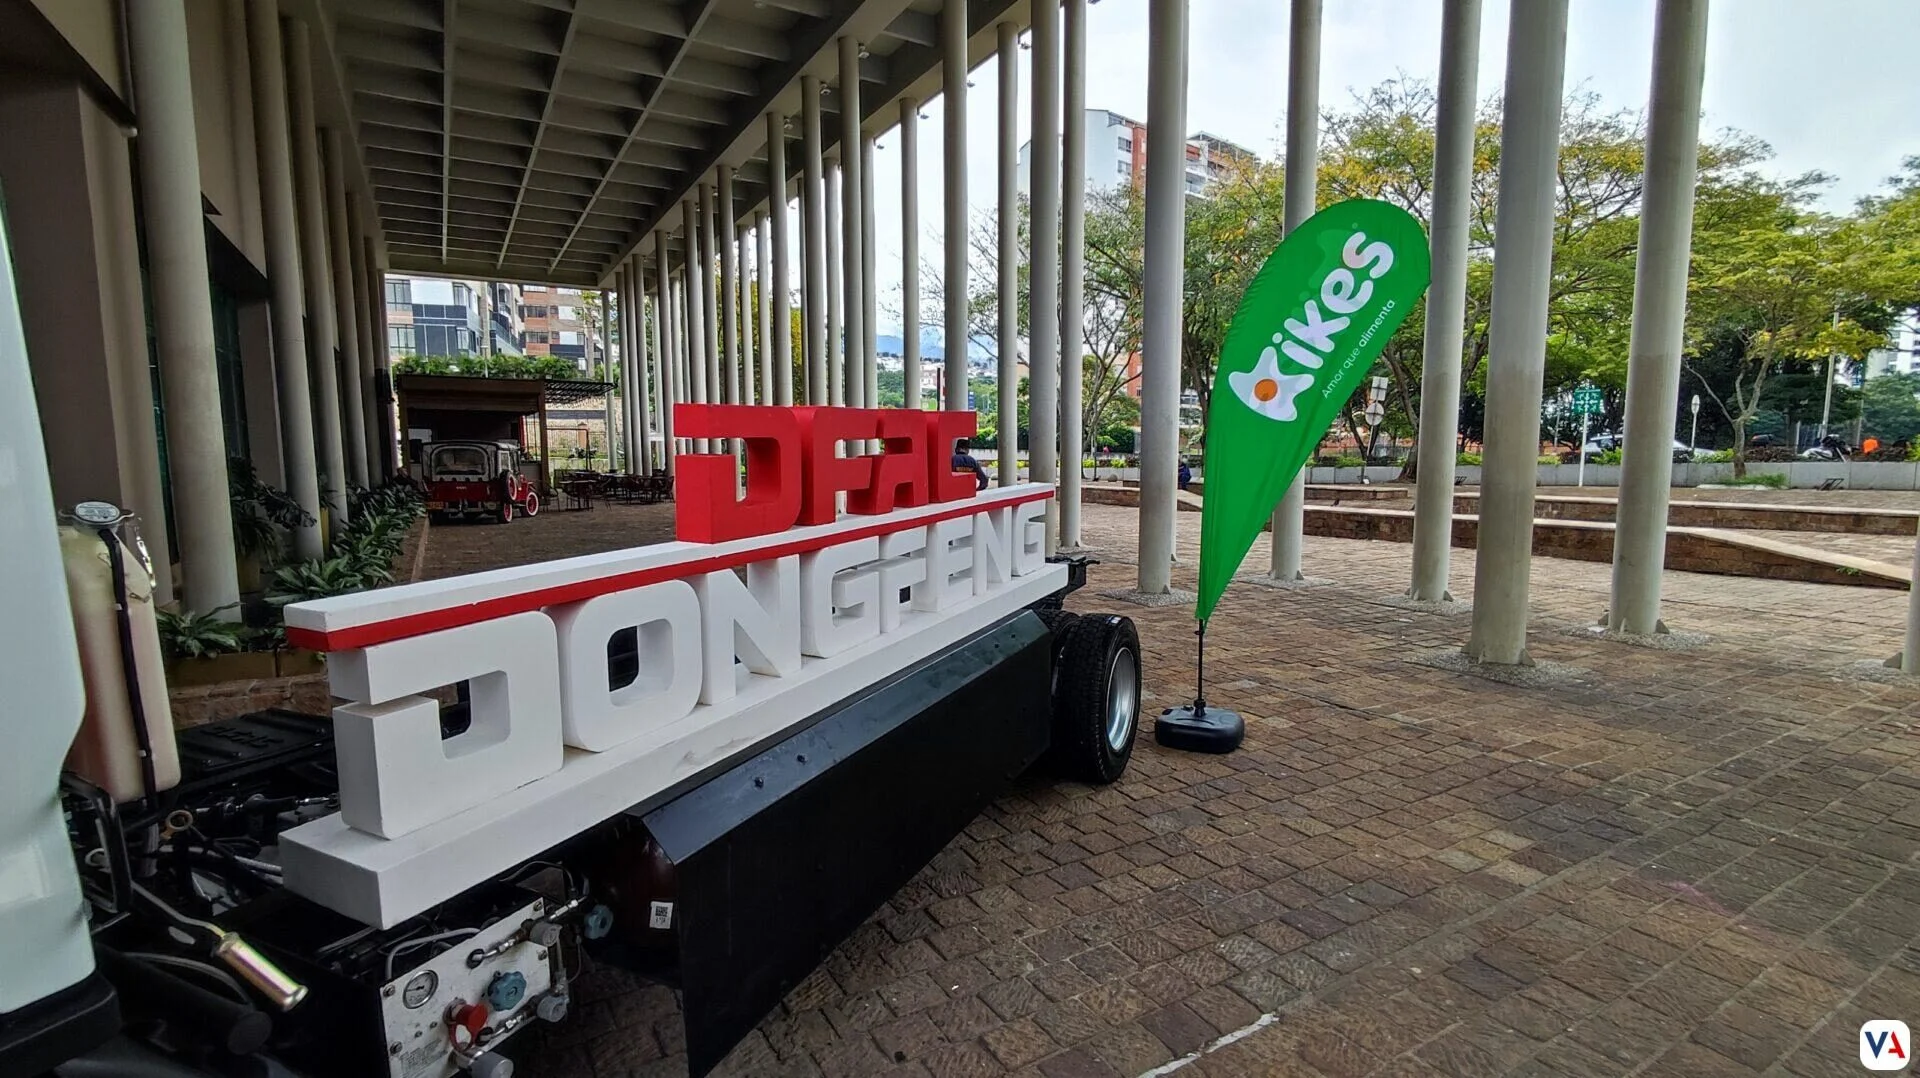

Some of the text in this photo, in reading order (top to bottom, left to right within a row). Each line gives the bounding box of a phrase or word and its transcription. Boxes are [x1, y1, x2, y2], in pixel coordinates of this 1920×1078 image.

[1322, 300, 1396, 399] Amor que alimenta
[674, 403, 977, 544] DFAC
[329, 500, 1047, 841] DONGFENG
